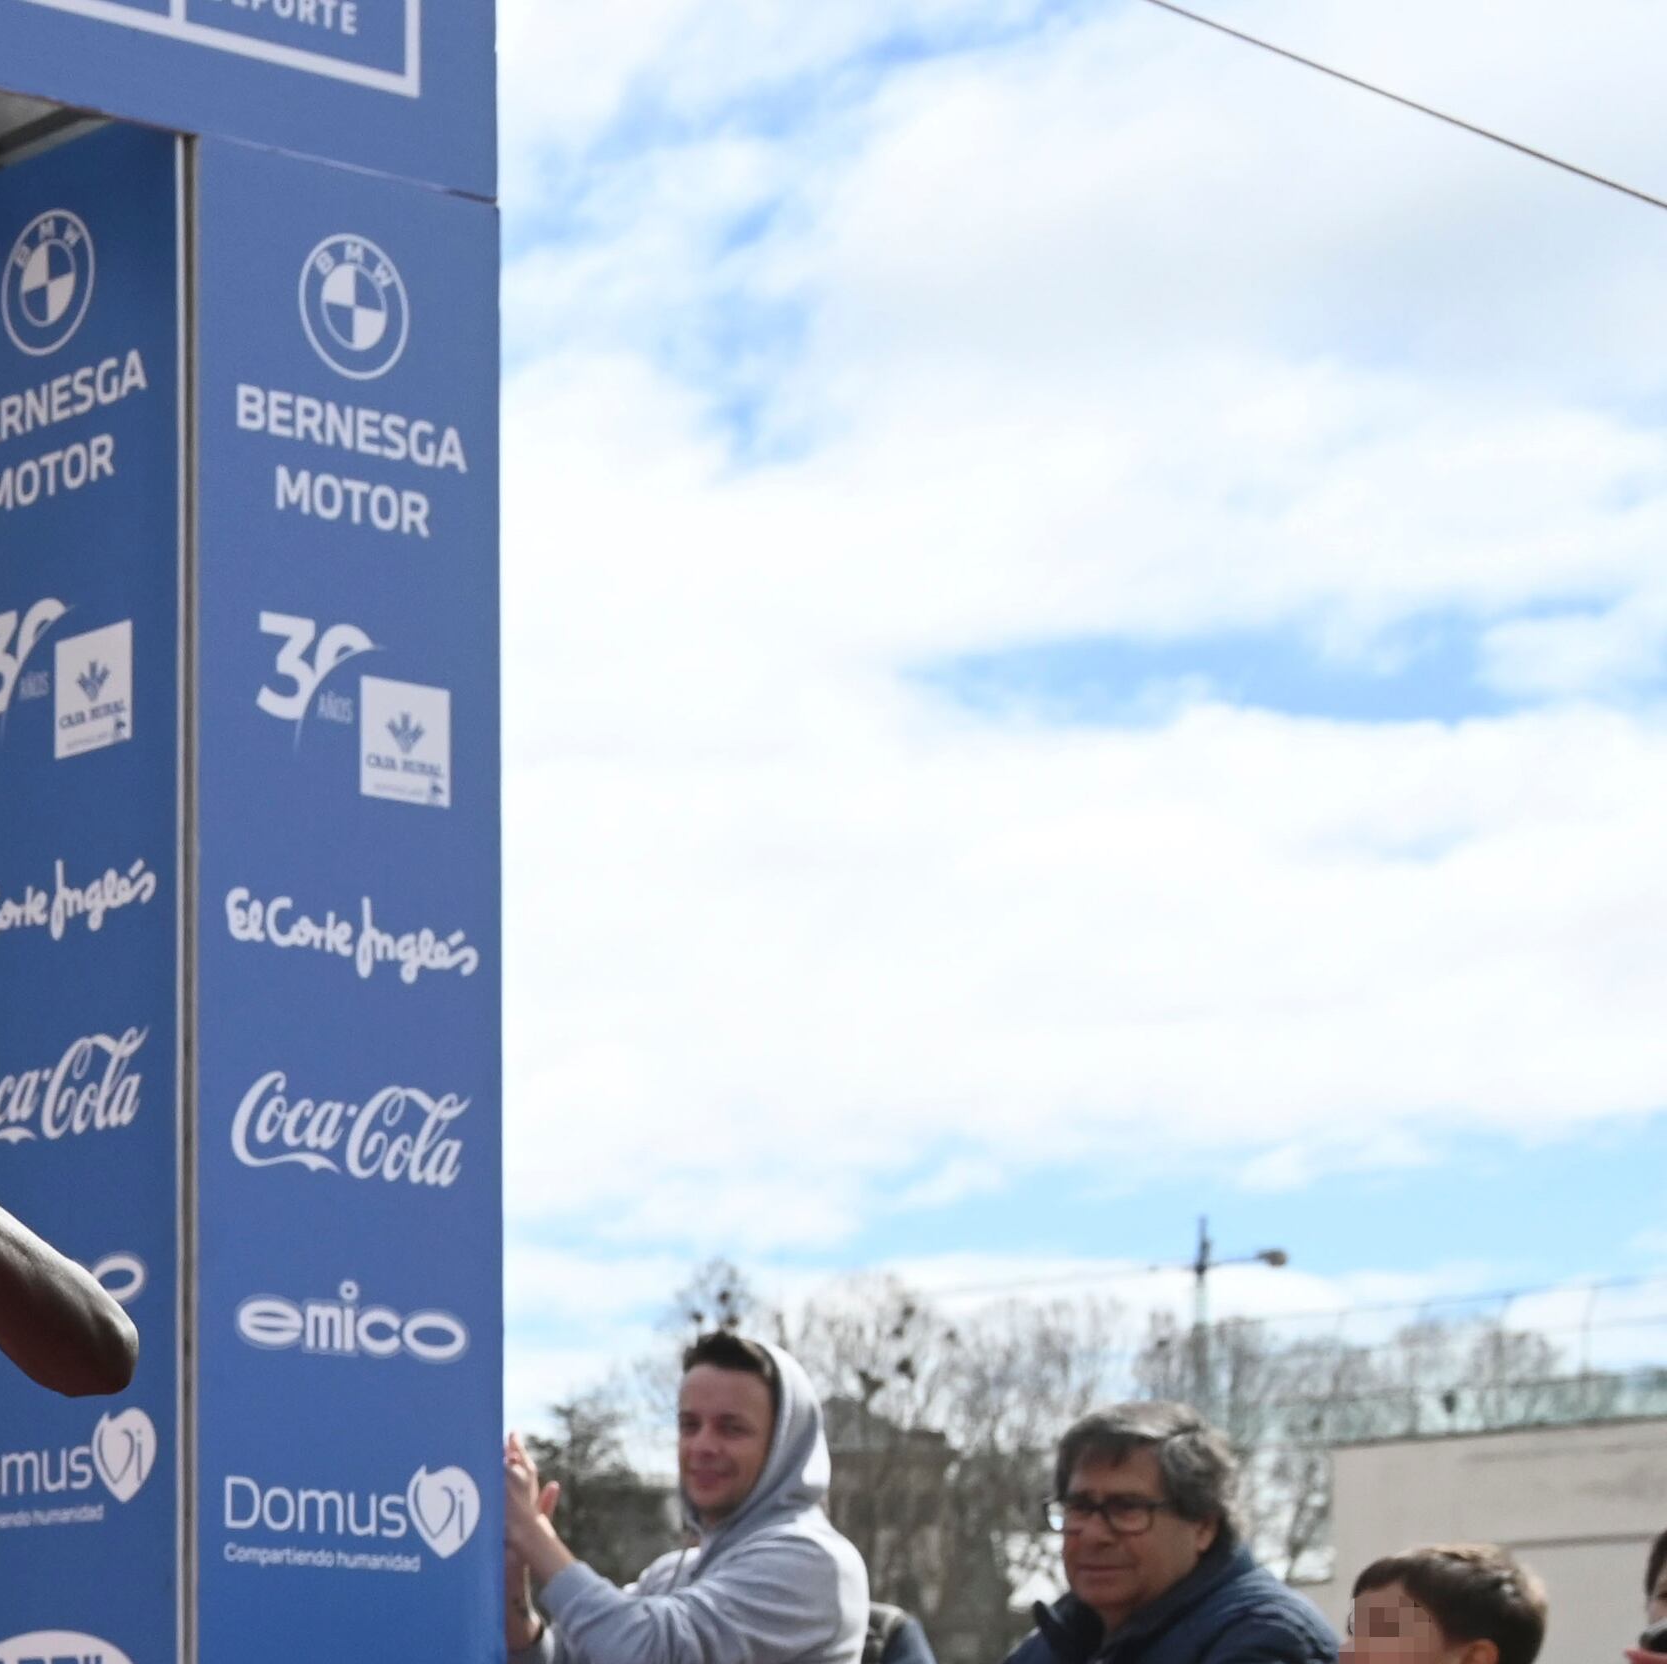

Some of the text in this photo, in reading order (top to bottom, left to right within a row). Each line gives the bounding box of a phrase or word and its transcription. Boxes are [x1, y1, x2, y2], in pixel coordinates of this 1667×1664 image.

[236, 383, 467, 473] BERNESGA
[275, 465, 430, 538] MOTOR
[49, 858, 156, 940] Inglés
[227, 887, 479, 984] El Corte Inglés
[237, 1280, 468, 1361] emico
[224, 1542, 421, 1573] Compartiendo humanidad
